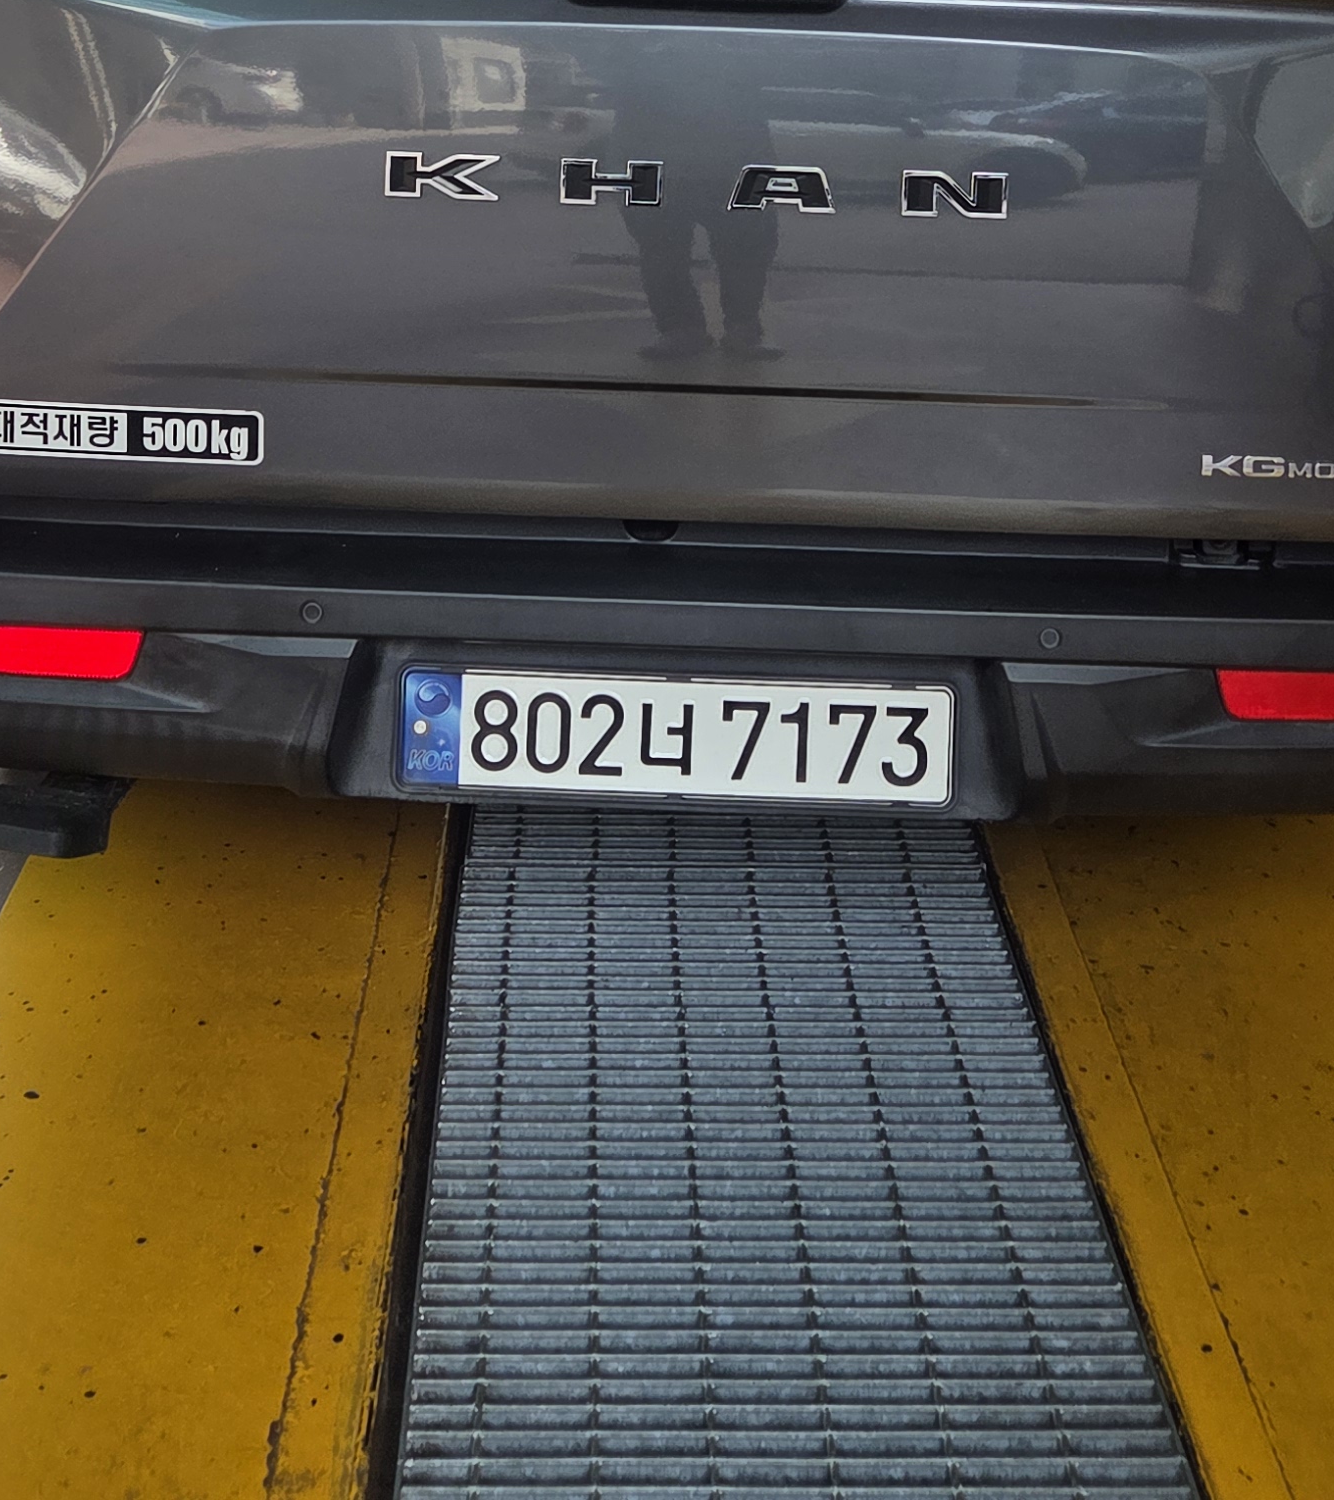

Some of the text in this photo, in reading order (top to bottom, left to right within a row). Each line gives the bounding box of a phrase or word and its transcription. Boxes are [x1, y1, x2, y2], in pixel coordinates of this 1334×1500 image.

[384, 150, 1009, 219] KHAN
[142, 416, 249, 461] 500kg
[406, 748, 454, 772] KOR
[470, 690, 930, 788] 802너 7173
